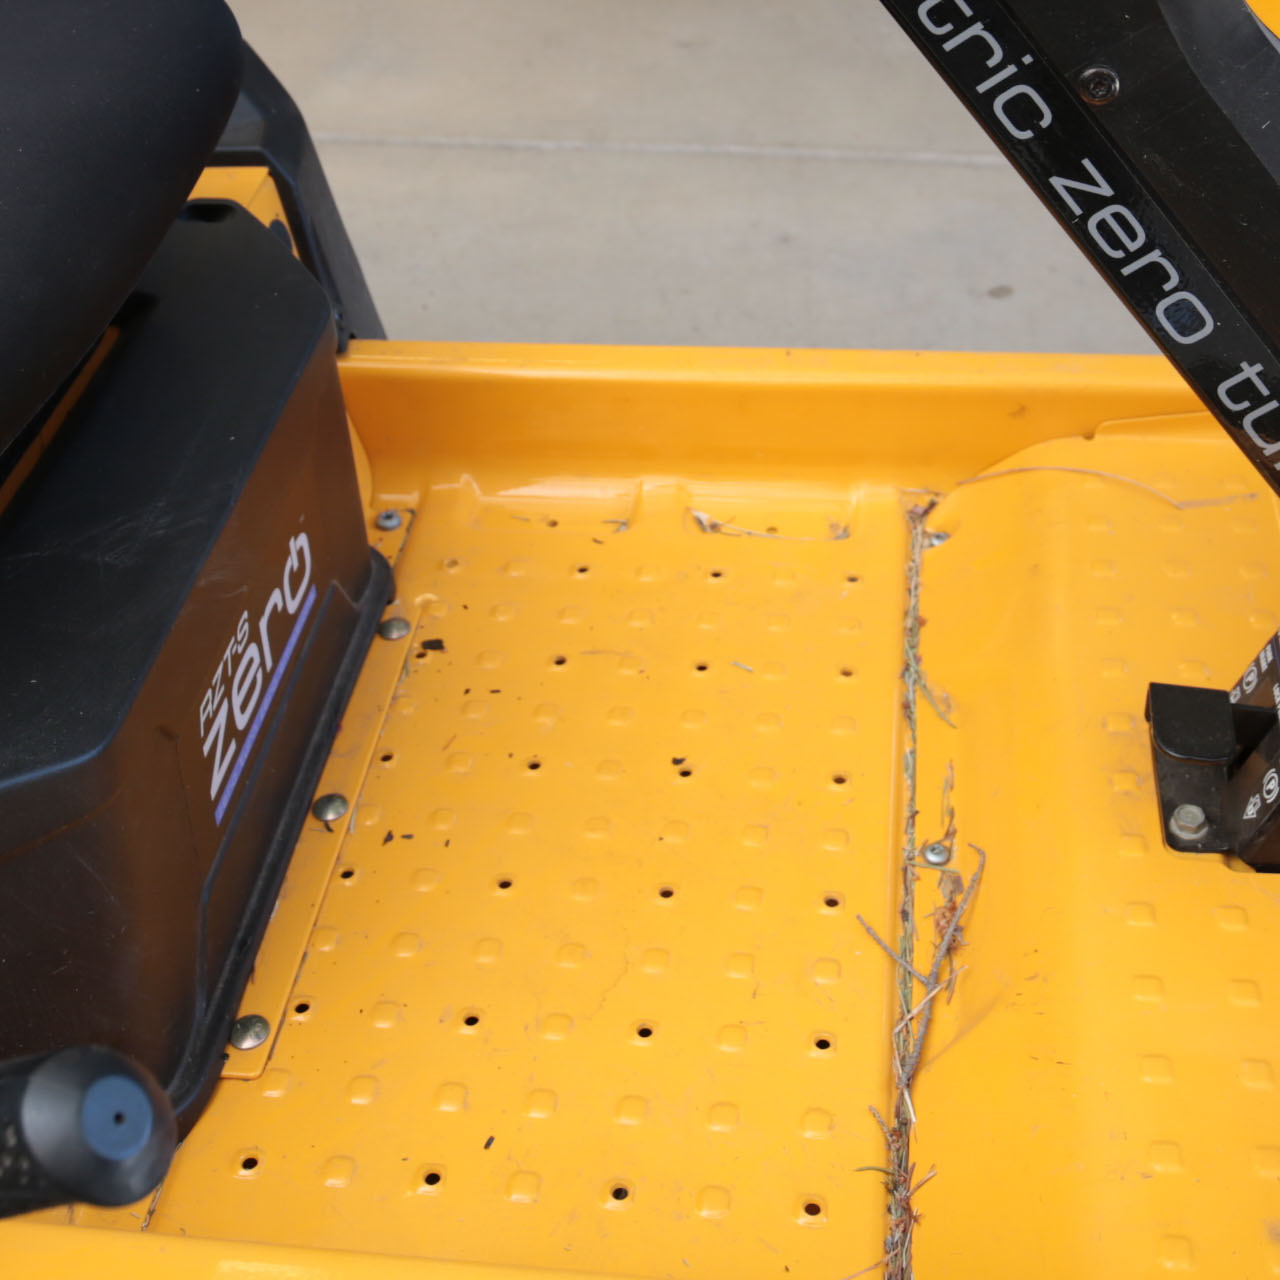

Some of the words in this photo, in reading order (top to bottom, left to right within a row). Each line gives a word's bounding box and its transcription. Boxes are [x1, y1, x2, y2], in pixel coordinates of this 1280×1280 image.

[1048, 158, 1215, 345] zero
[203, 531, 312, 800] zero
[1272, 682, 1280, 704] LOCK
